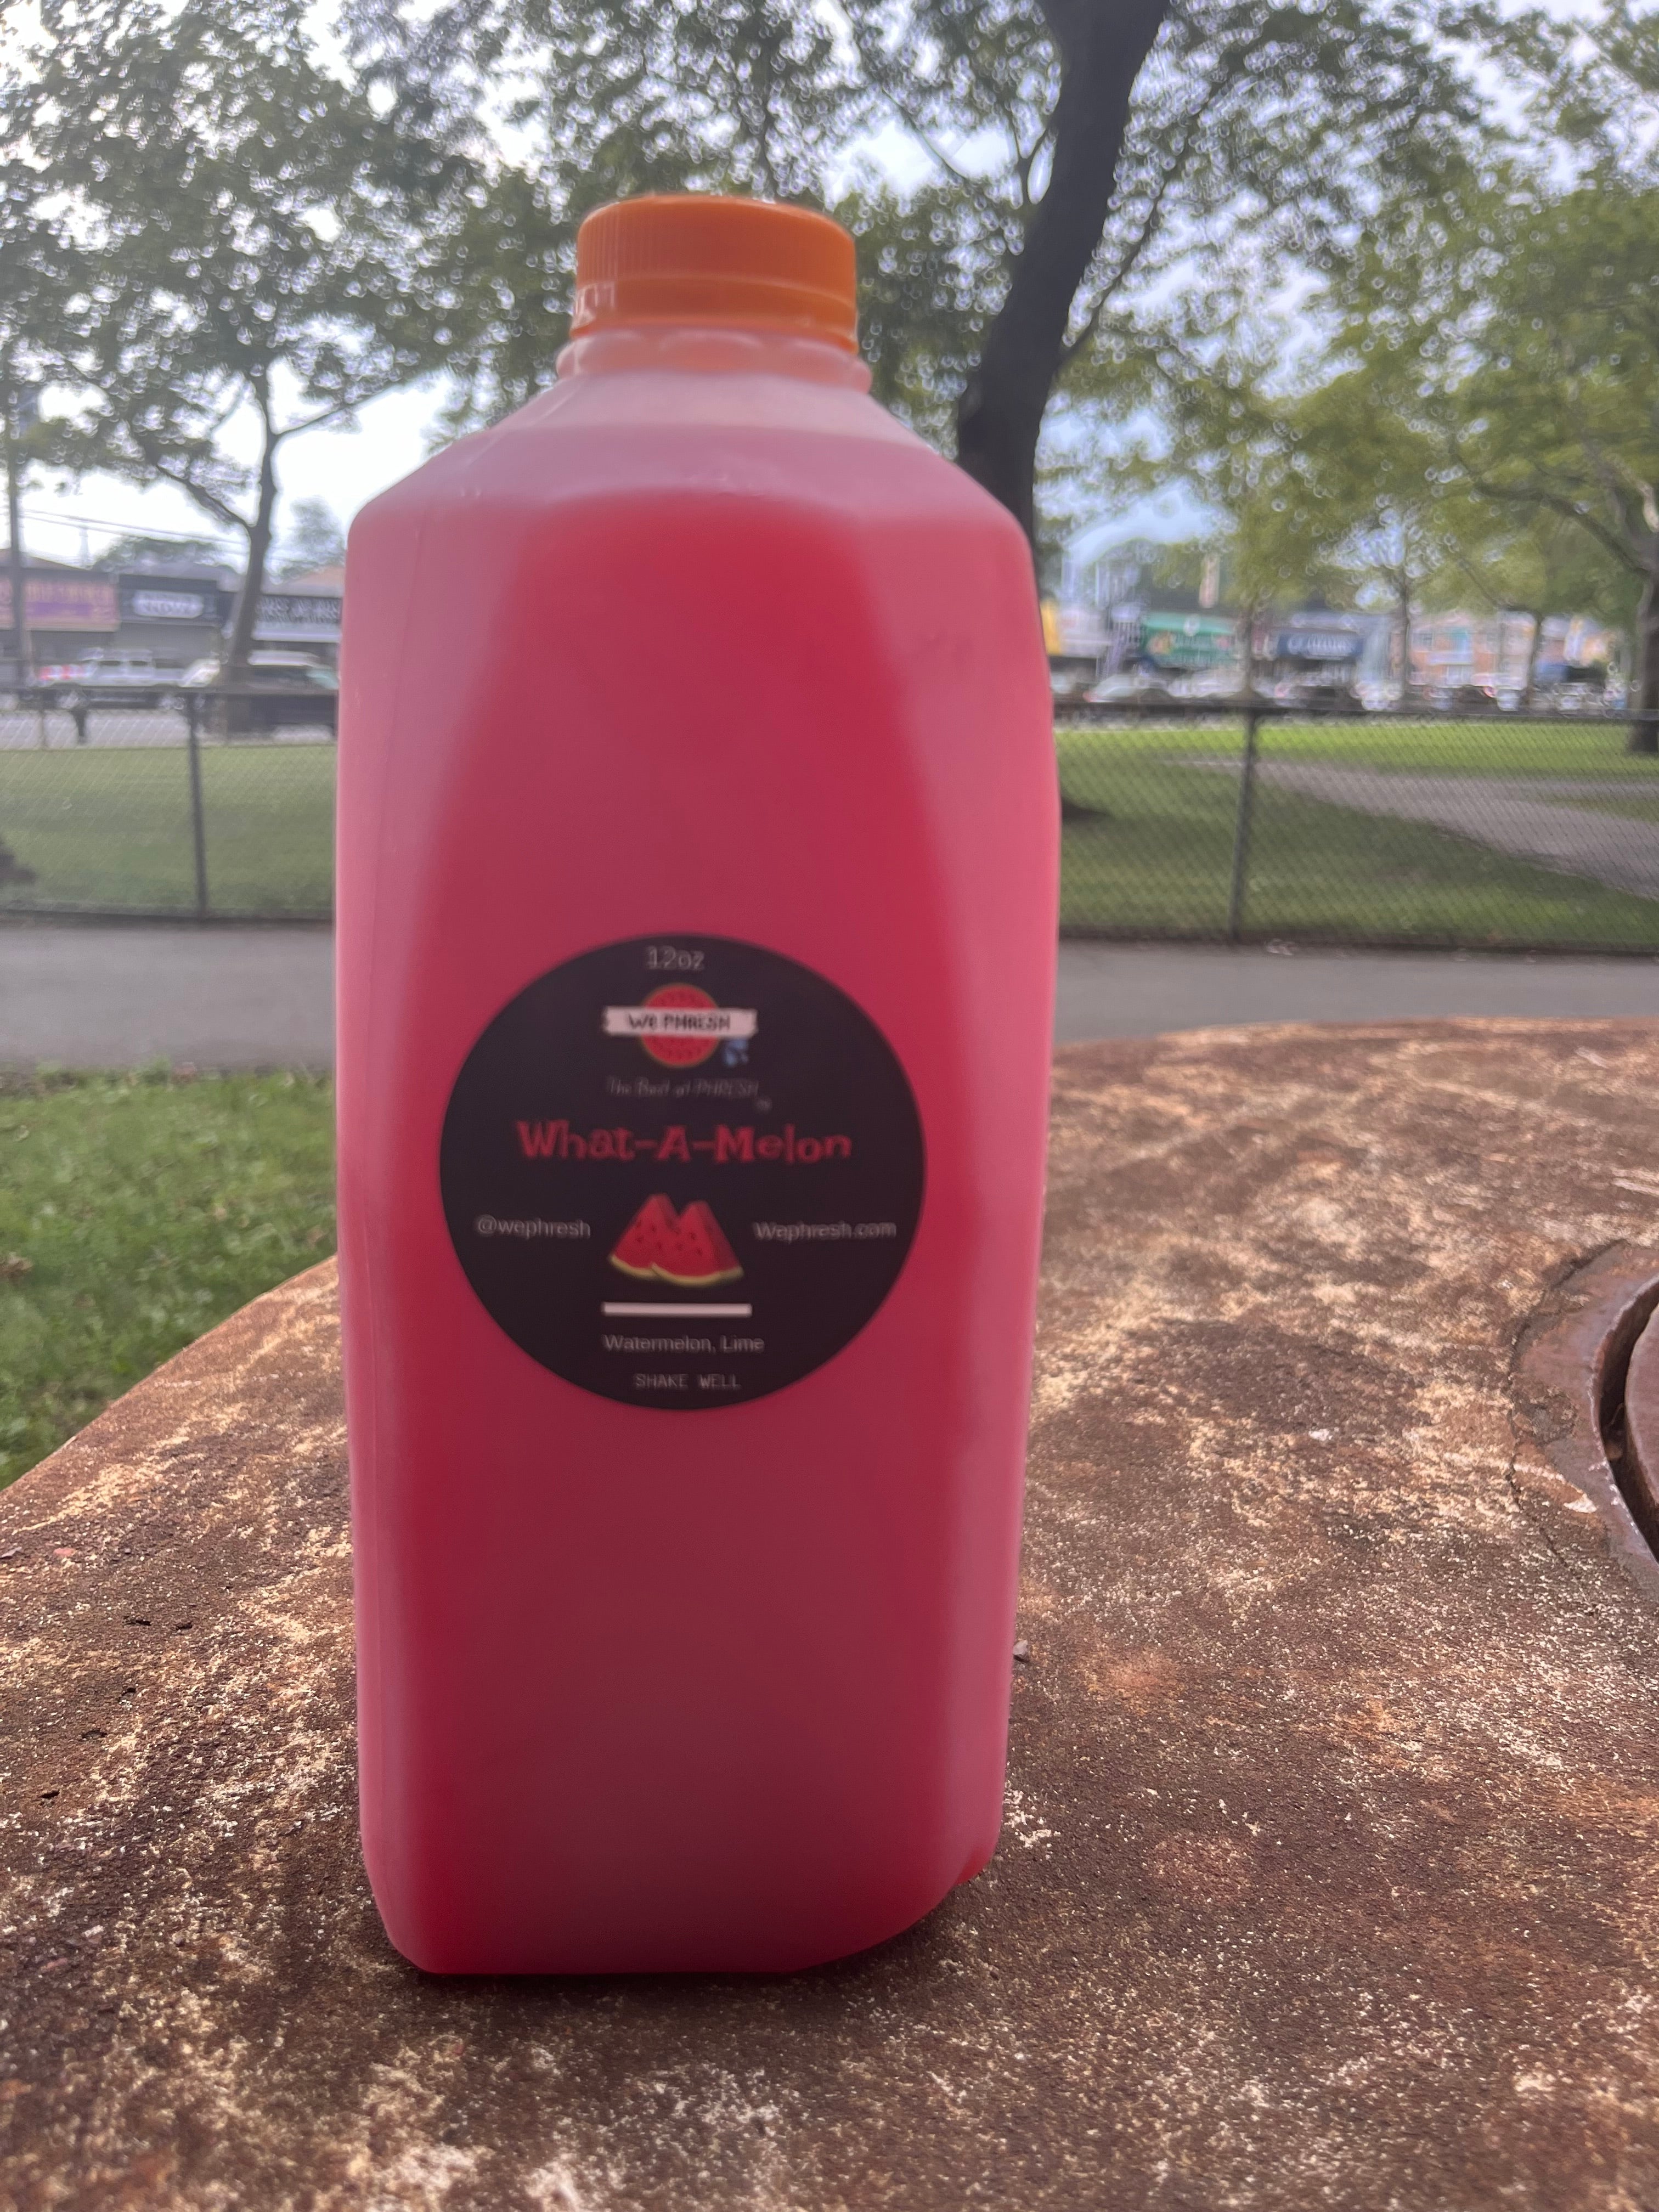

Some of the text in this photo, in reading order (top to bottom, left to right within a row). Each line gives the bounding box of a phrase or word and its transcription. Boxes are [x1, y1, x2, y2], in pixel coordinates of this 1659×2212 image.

[646, 945, 705, 970] 12oz
[664, 1014, 731, 1030] PHRESH
[517, 1120, 852, 1164] What-A-Melon
[478, 1215, 591, 1240] @wephresh
[603, 1335, 765, 1353] Watermelon, Lime
[635, 1373, 741, 1390] SHAKE WELL
